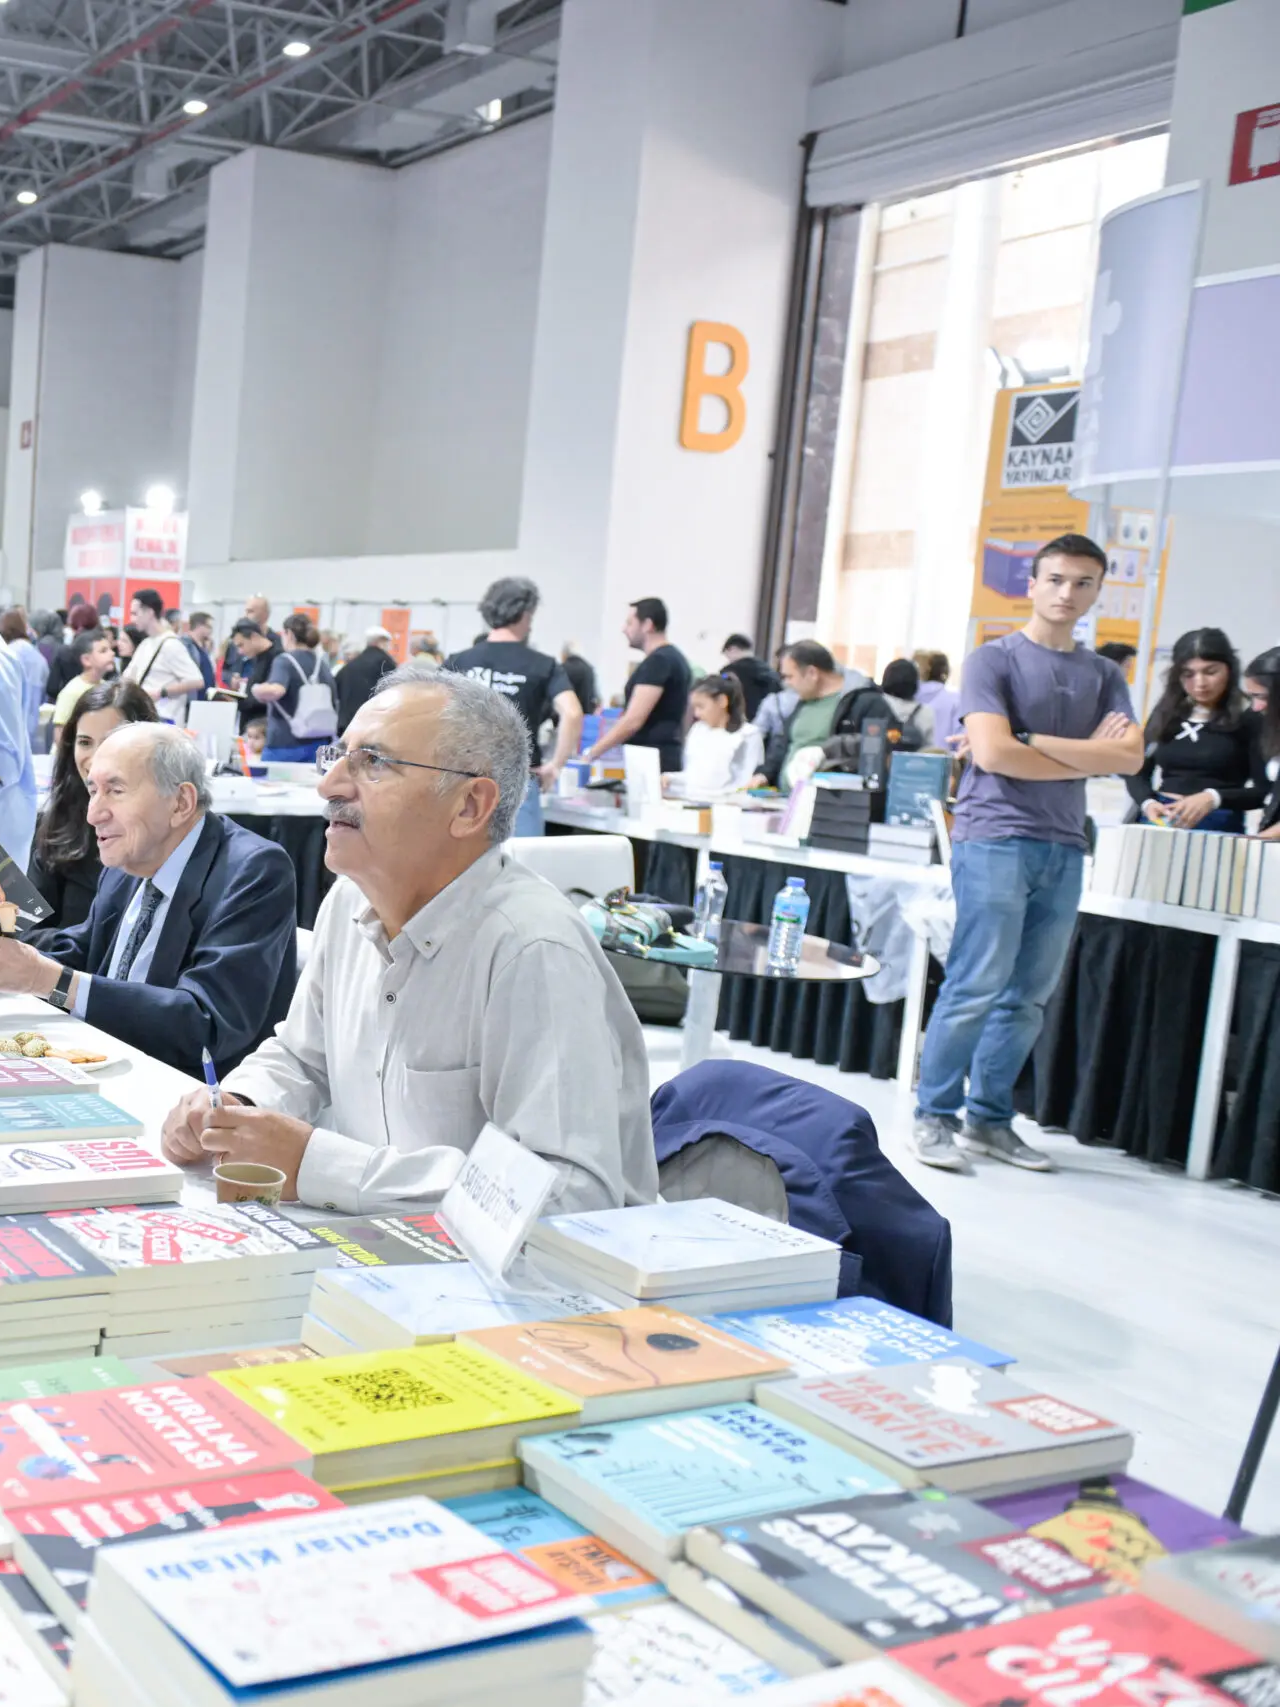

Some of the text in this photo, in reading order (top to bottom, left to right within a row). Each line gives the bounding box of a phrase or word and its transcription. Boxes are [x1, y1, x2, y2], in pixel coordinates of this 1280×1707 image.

[679, 319, 749, 454] B
[118, 1389, 224, 1471] NOKTASI
[151, 1385, 261, 1467] KIRILMA
[707, 1414, 807, 1465] AYSEVER
[728, 1408, 807, 1448] ENVER
[295, 1520, 446, 1560] Dostlar
[759, 1516, 948, 1628] SORULAR
[796, 1511, 1004, 1618] AYKIRI
